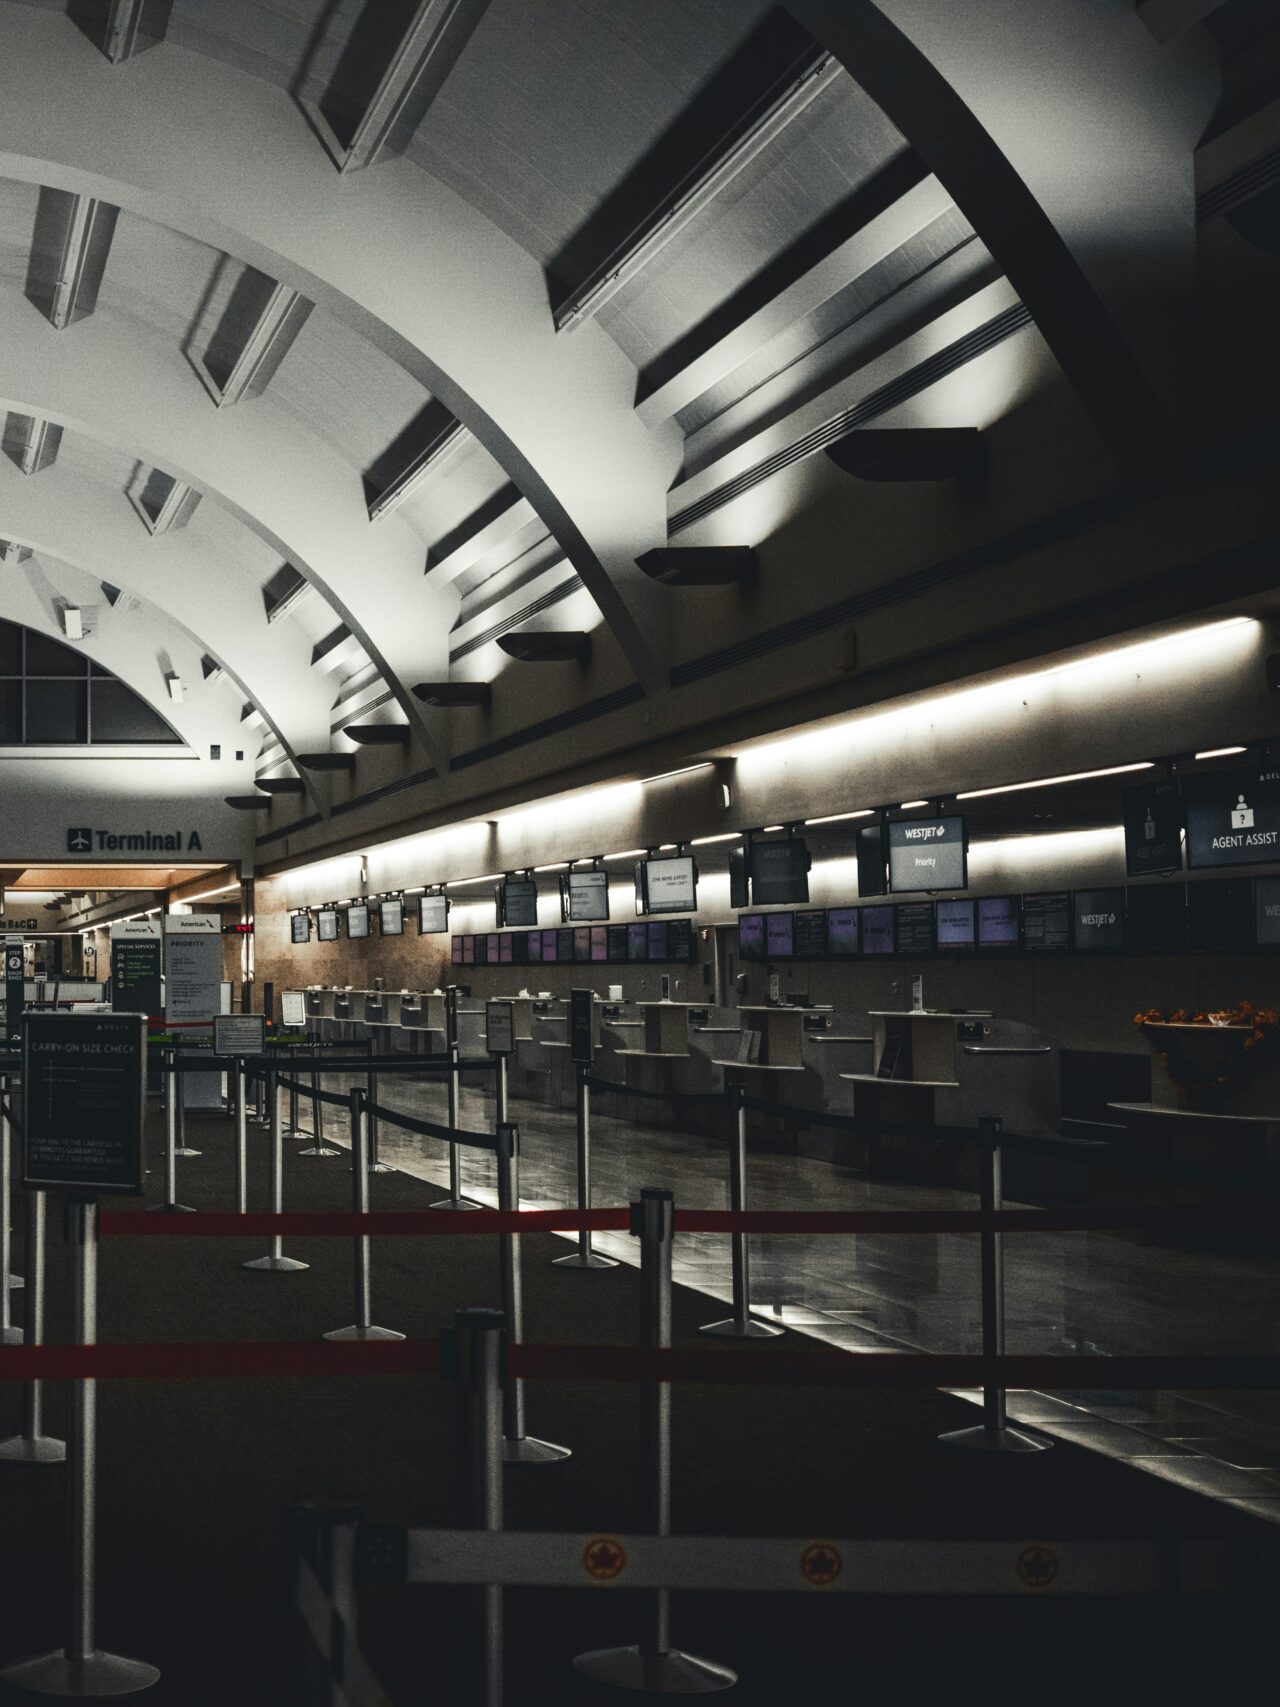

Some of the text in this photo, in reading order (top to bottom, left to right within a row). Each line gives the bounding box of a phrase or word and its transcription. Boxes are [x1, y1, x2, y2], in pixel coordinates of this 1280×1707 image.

[1266, 772, 1280, 780] DEL
[905, 826, 937, 840] WESTJET
[96, 830, 202, 851] Terminal A
[1212, 832, 1278, 849] AGENT ASSIST
[915, 856, 936, 868] Priority
[1081, 914, 1108, 928] WESTJET
[12, 958, 18, 967] 2
[32, 1043, 134, 1054] CARRY-ON SIZE CHECK
